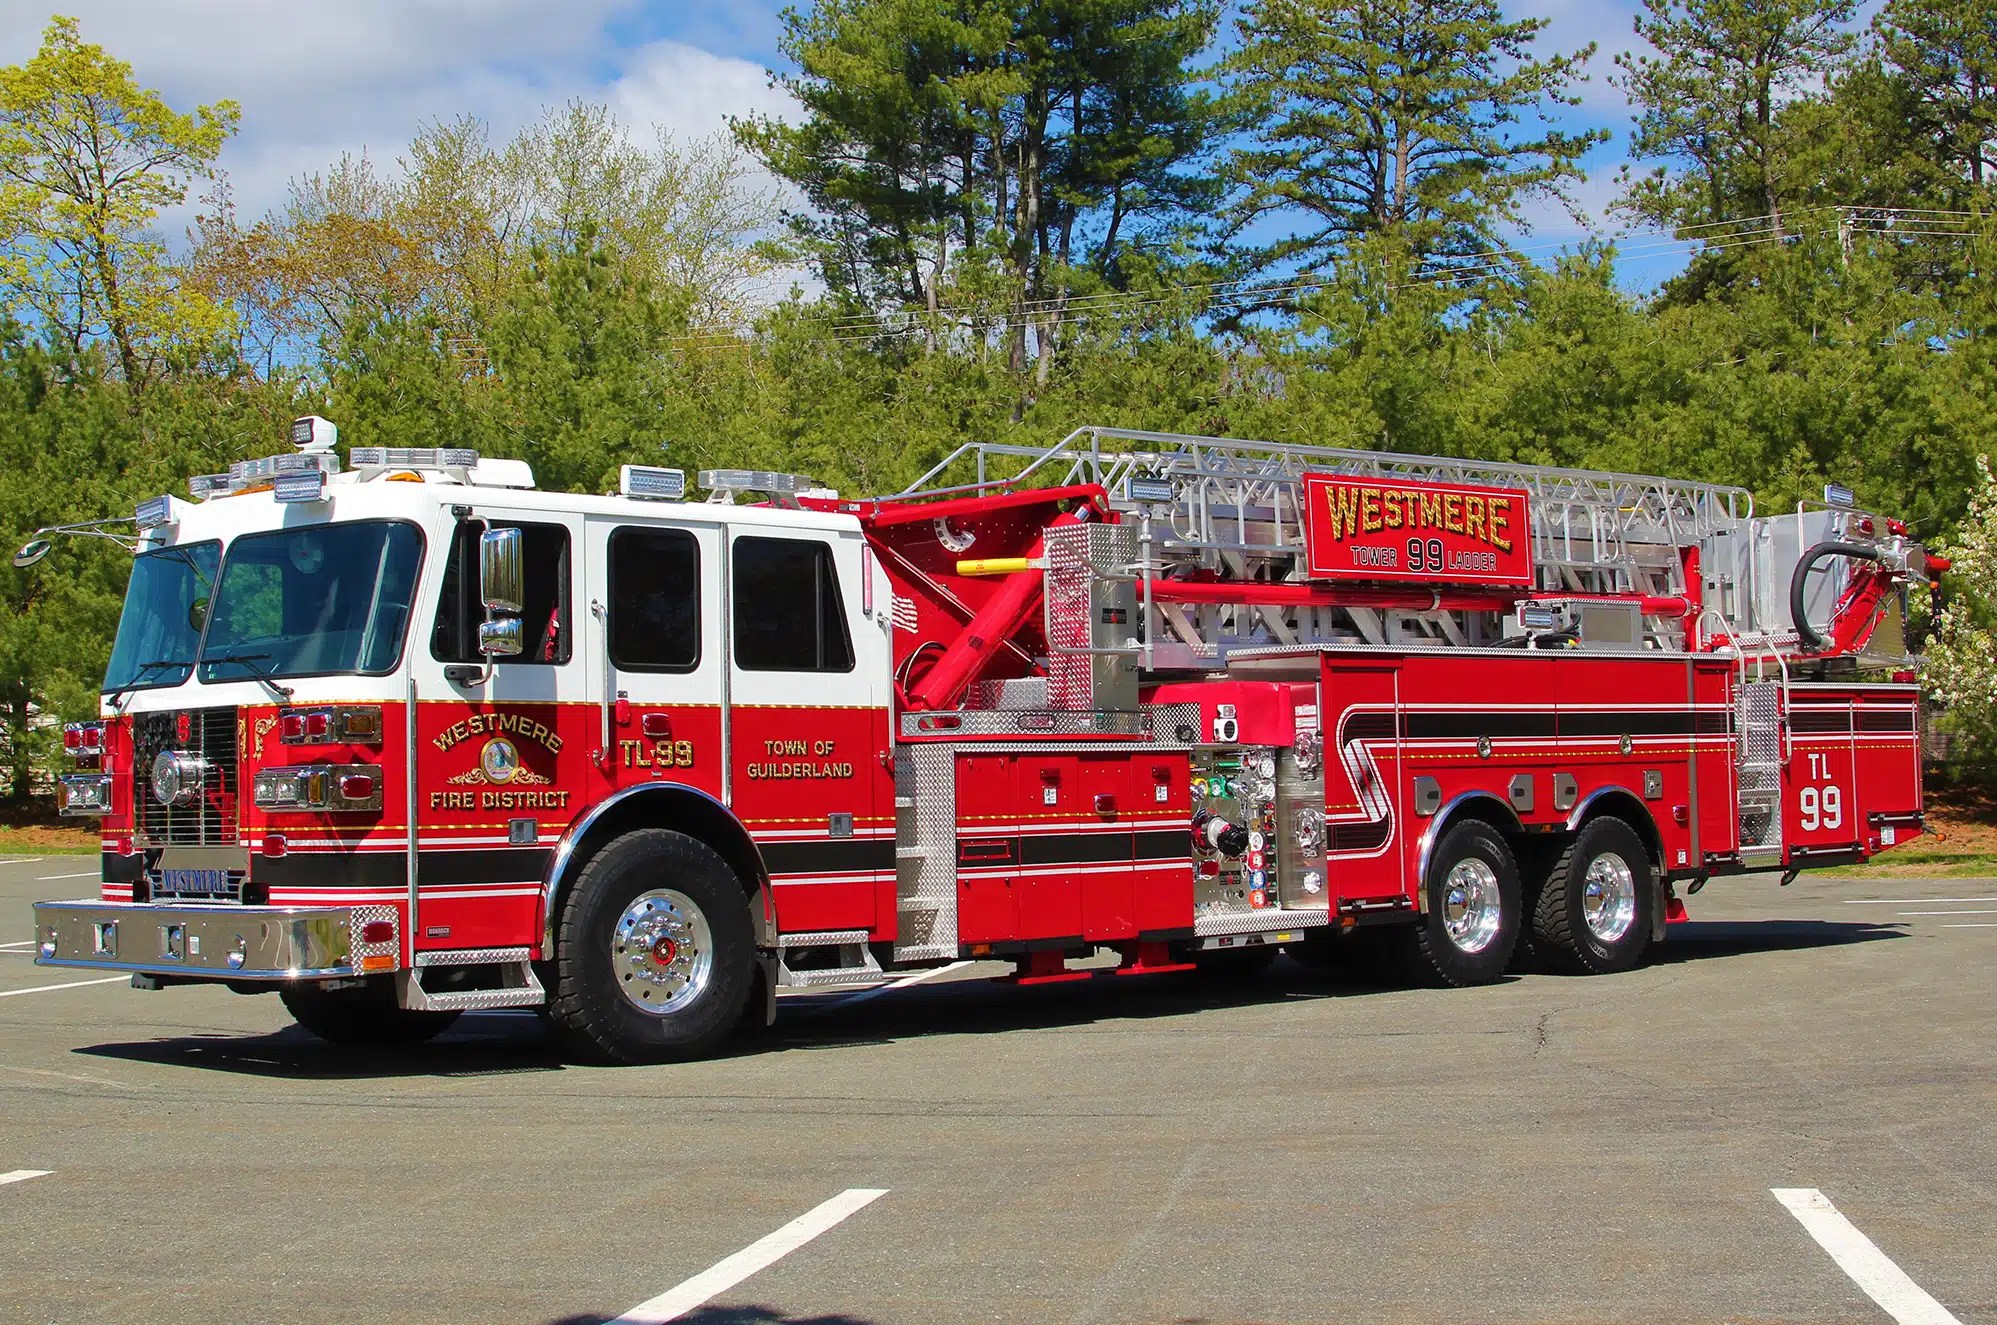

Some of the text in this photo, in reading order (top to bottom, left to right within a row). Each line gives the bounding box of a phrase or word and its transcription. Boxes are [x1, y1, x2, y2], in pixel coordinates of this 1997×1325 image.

[1324, 485, 1512, 550] WESTMERE
[1350, 537, 1497, 573] TOWER 99 LADDER
[432, 713, 564, 754] WESTMERE
[764, 740, 834, 756] TOWN OF
[747, 763, 853, 778] GUILDERLAND
[1808, 753, 1832, 780] TL
[430, 791, 569, 809] FIRE DISTRICT
[1800, 785, 1841, 831] 99
[162, 869, 229, 892] WESTMERE
